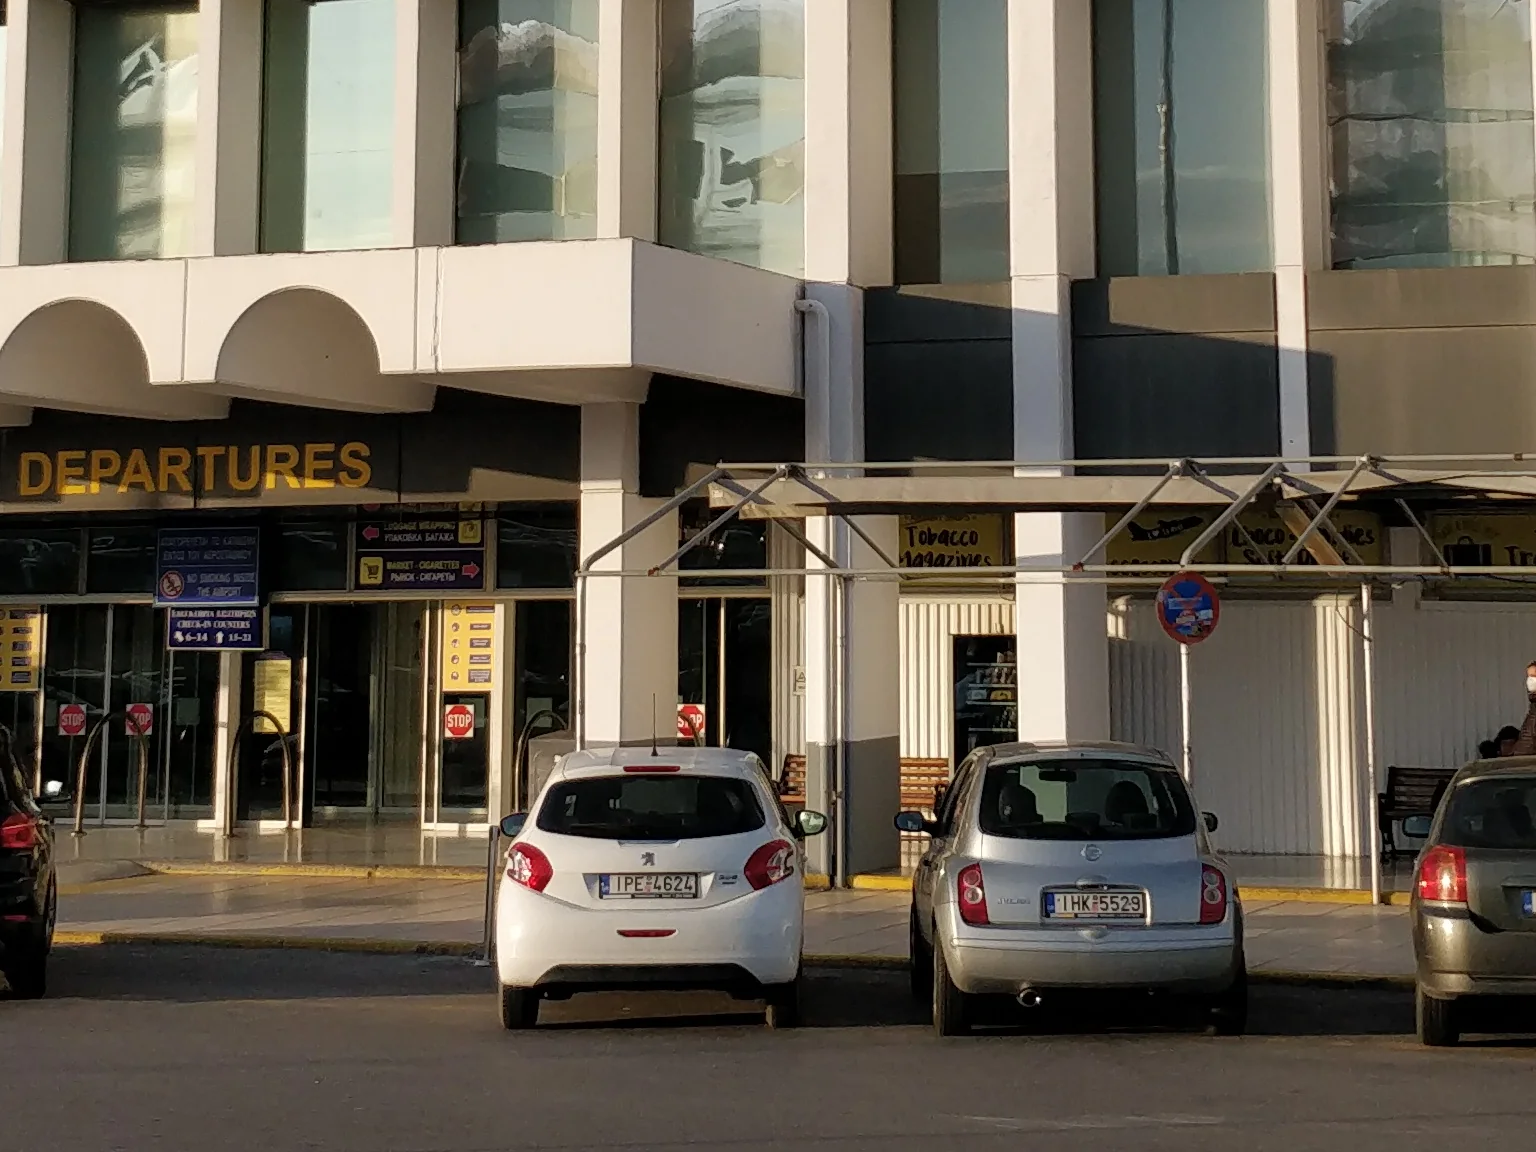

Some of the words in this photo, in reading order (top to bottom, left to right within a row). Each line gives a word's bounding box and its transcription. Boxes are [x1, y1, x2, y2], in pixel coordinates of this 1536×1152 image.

[19, 442, 373, 498] DEPARTURES
[905, 526, 979, 547] Tobacco
[61, 713, 85, 726] STOP
[447, 714, 472, 728] STOP
